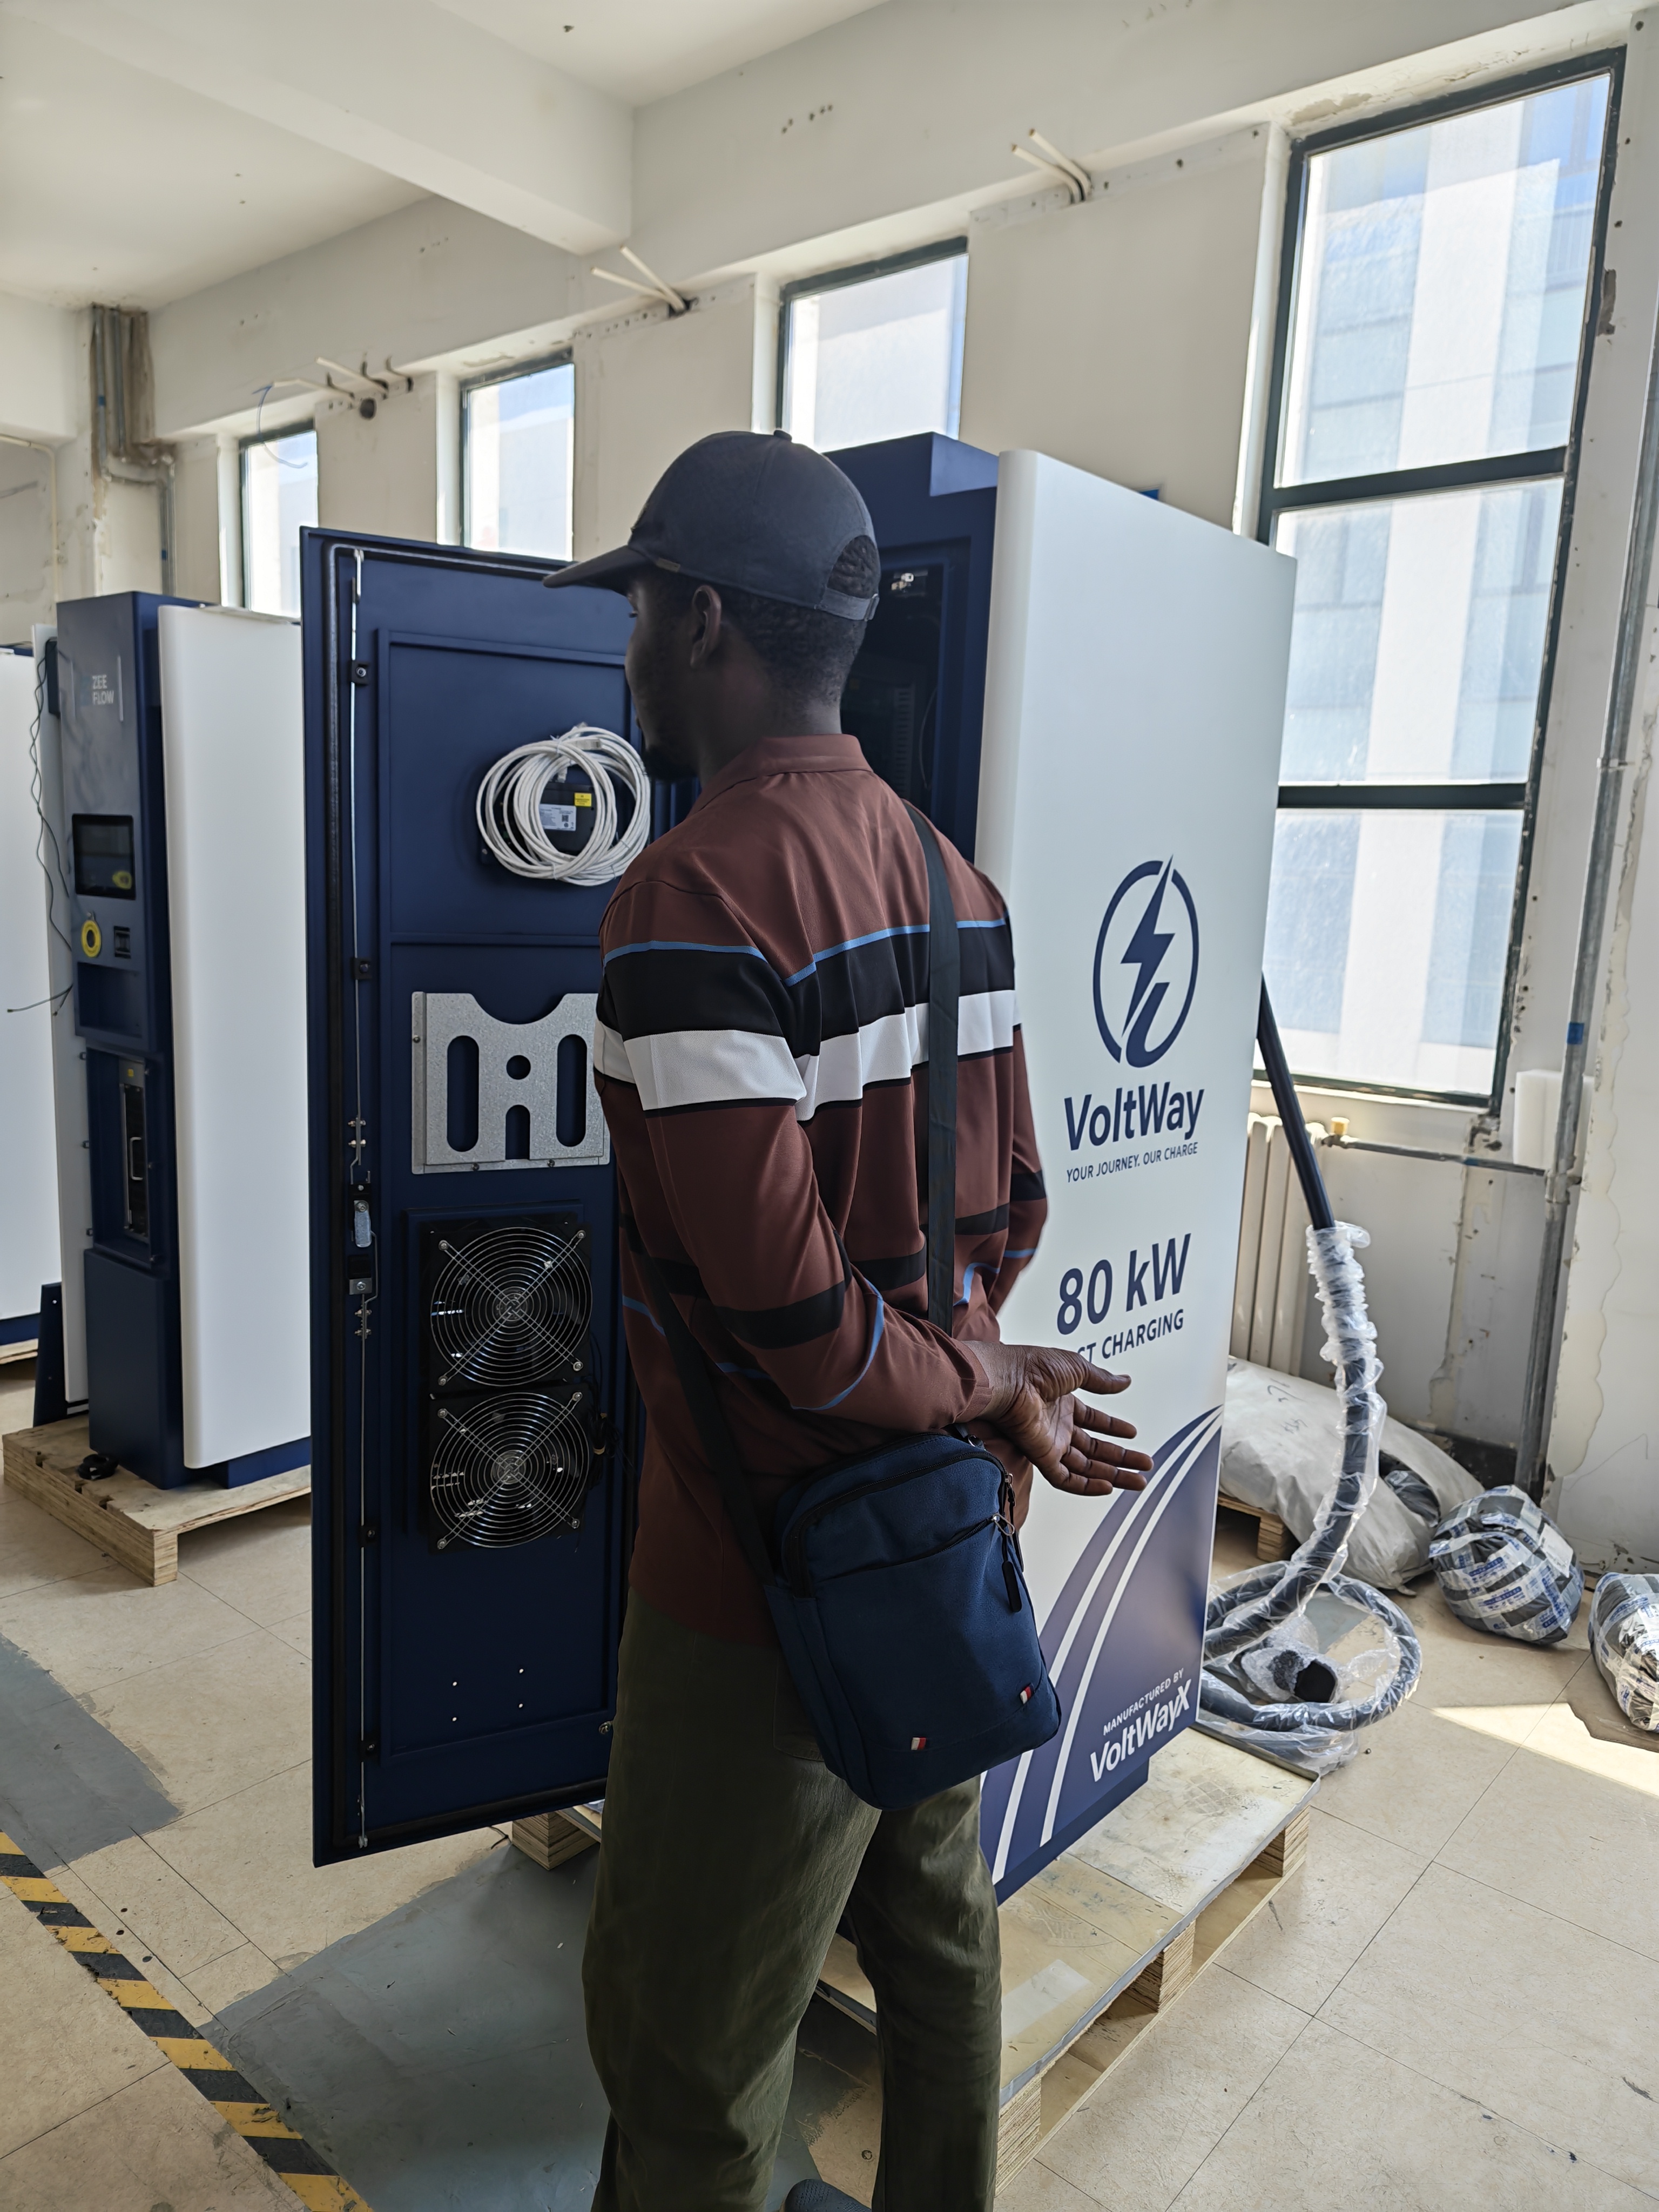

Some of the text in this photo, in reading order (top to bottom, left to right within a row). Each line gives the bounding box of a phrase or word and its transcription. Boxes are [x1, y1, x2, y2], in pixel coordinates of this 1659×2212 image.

[92, 675, 107, 690] ZEE
[92, 691, 114, 705] FLOW
[1064, 1082, 1204, 1150] VoltWay
[1067, 1142, 1198, 1182] YOUR JOURNEY. OUR CHARGE
[1057, 1233, 1191, 1334] 80 kW
[1102, 1309, 1183, 1359] CHARGING
[1090, 1679, 1191, 1782] VoltWayX
[1103, 1668, 1184, 1735] MANUFACTURED BY
